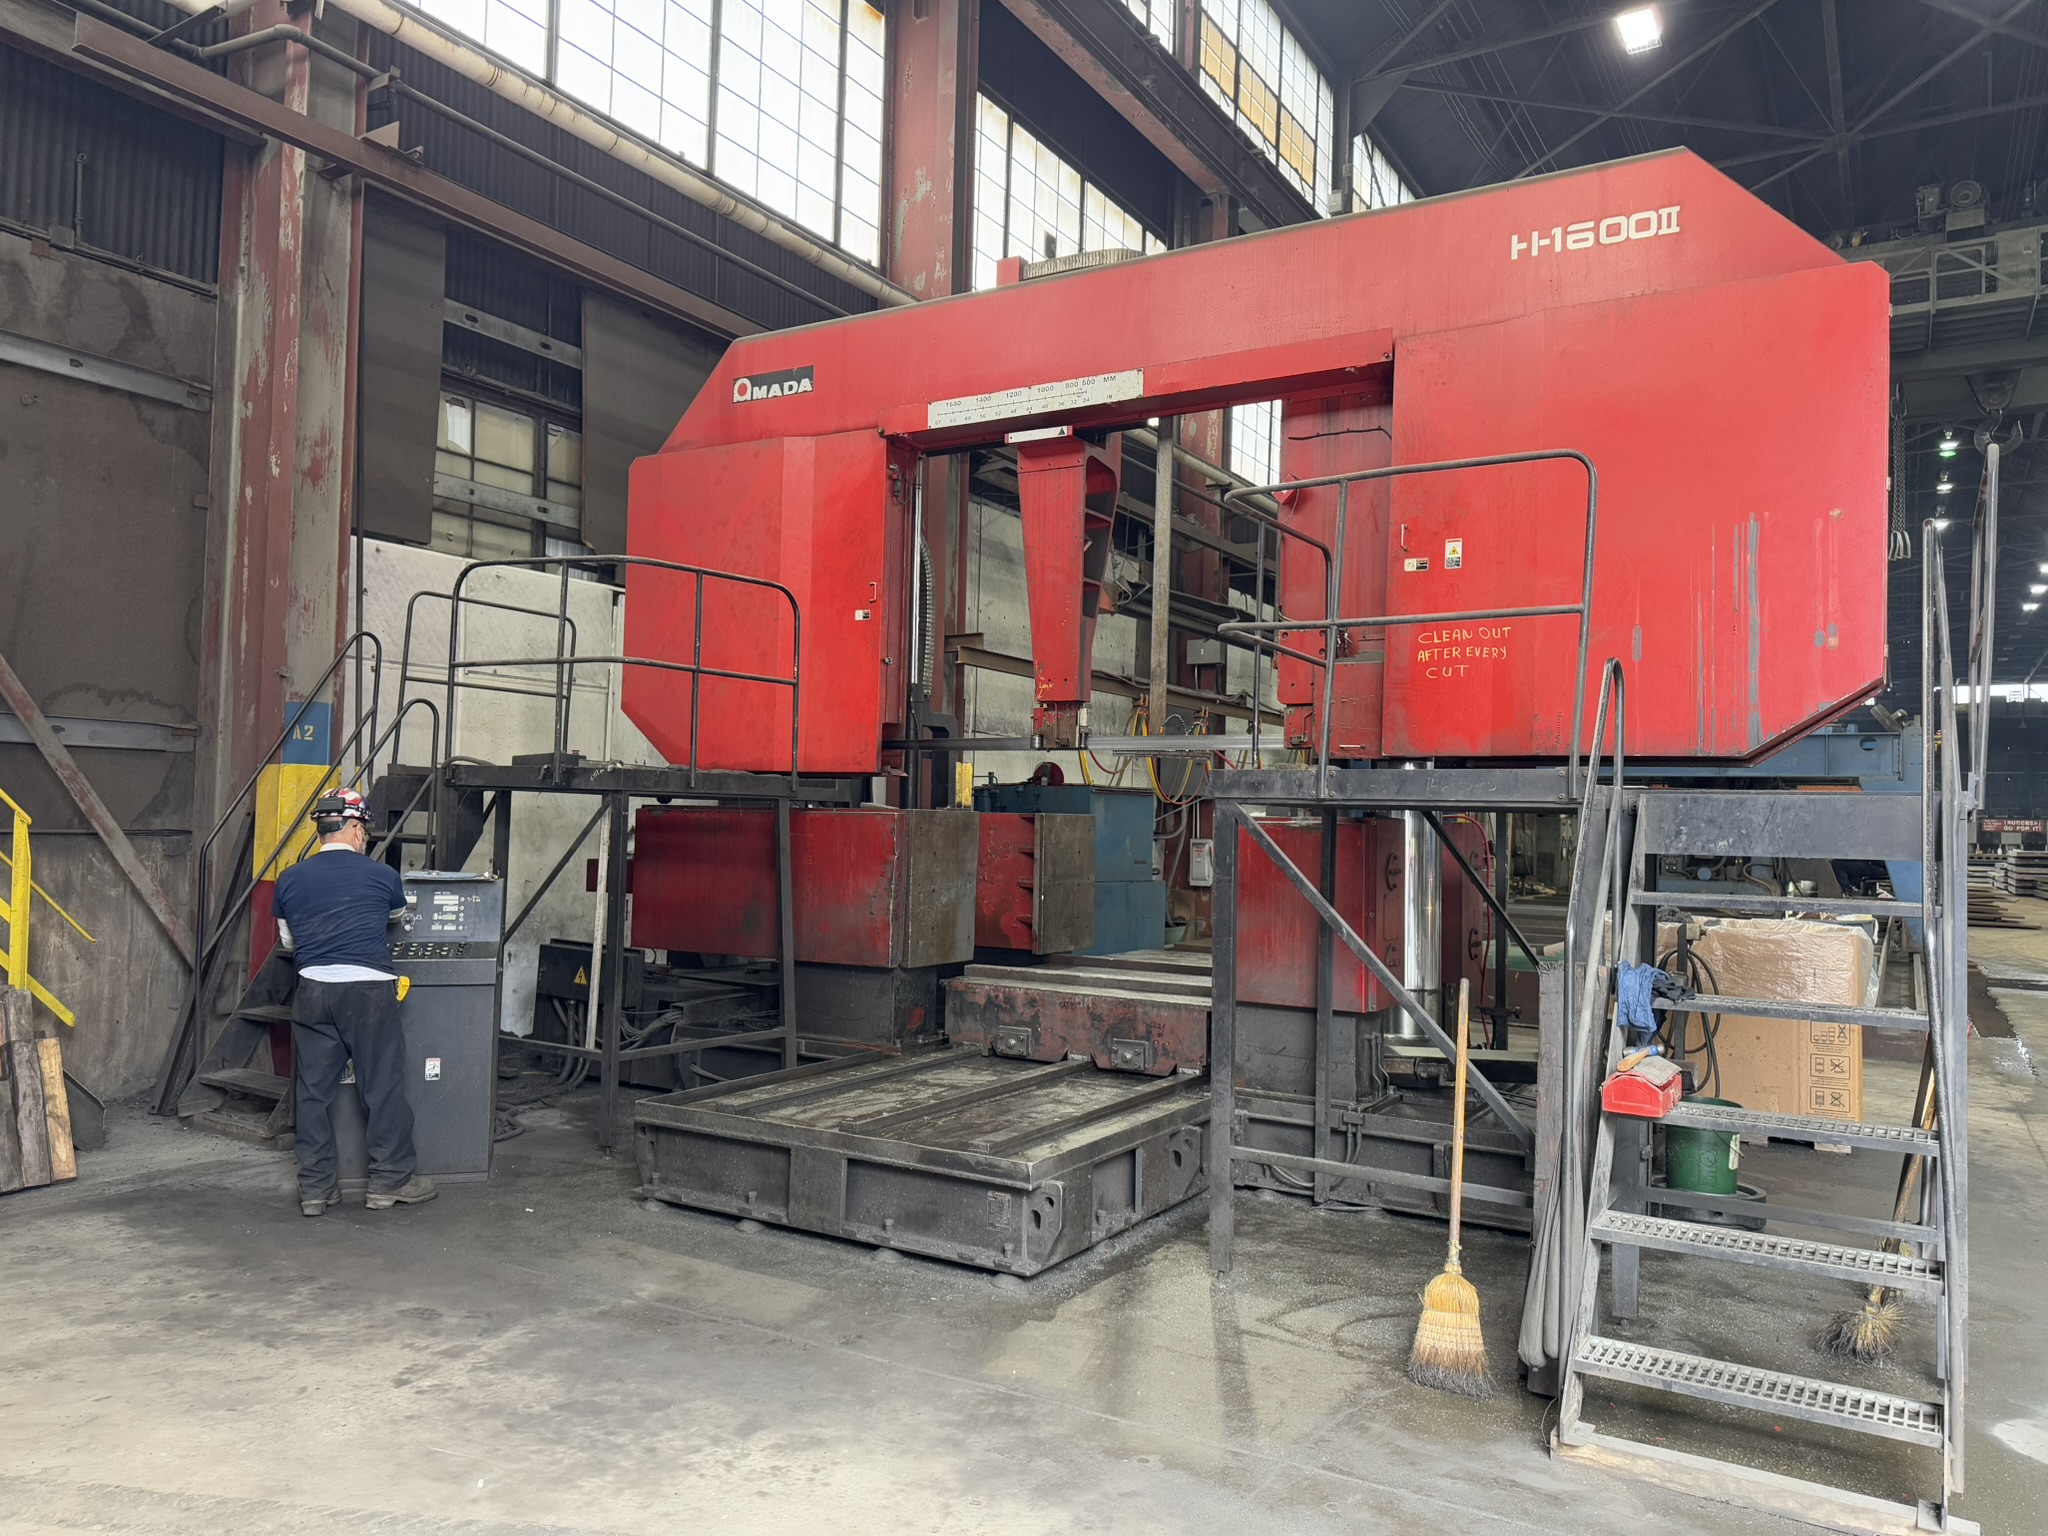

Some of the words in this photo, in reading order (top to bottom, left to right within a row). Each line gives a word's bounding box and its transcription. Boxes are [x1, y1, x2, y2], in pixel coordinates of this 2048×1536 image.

[733, 377, 813, 403] AMADA
[975, 395, 992, 404] 1400
[1006, 390, 1023, 398] 1200
[1037, 385, 1054, 393] 1000
[1065, 381, 1079, 389] 800
[1103, 375, 1117, 383] MM
[1417, 628, 1473, 644] CLEAN
[1478, 626, 1512, 639] OUT
[1417, 646, 1461, 662] AFTER
[1466, 645, 1507, 660] EVERY
[1425, 664, 1470, 679] CUT
